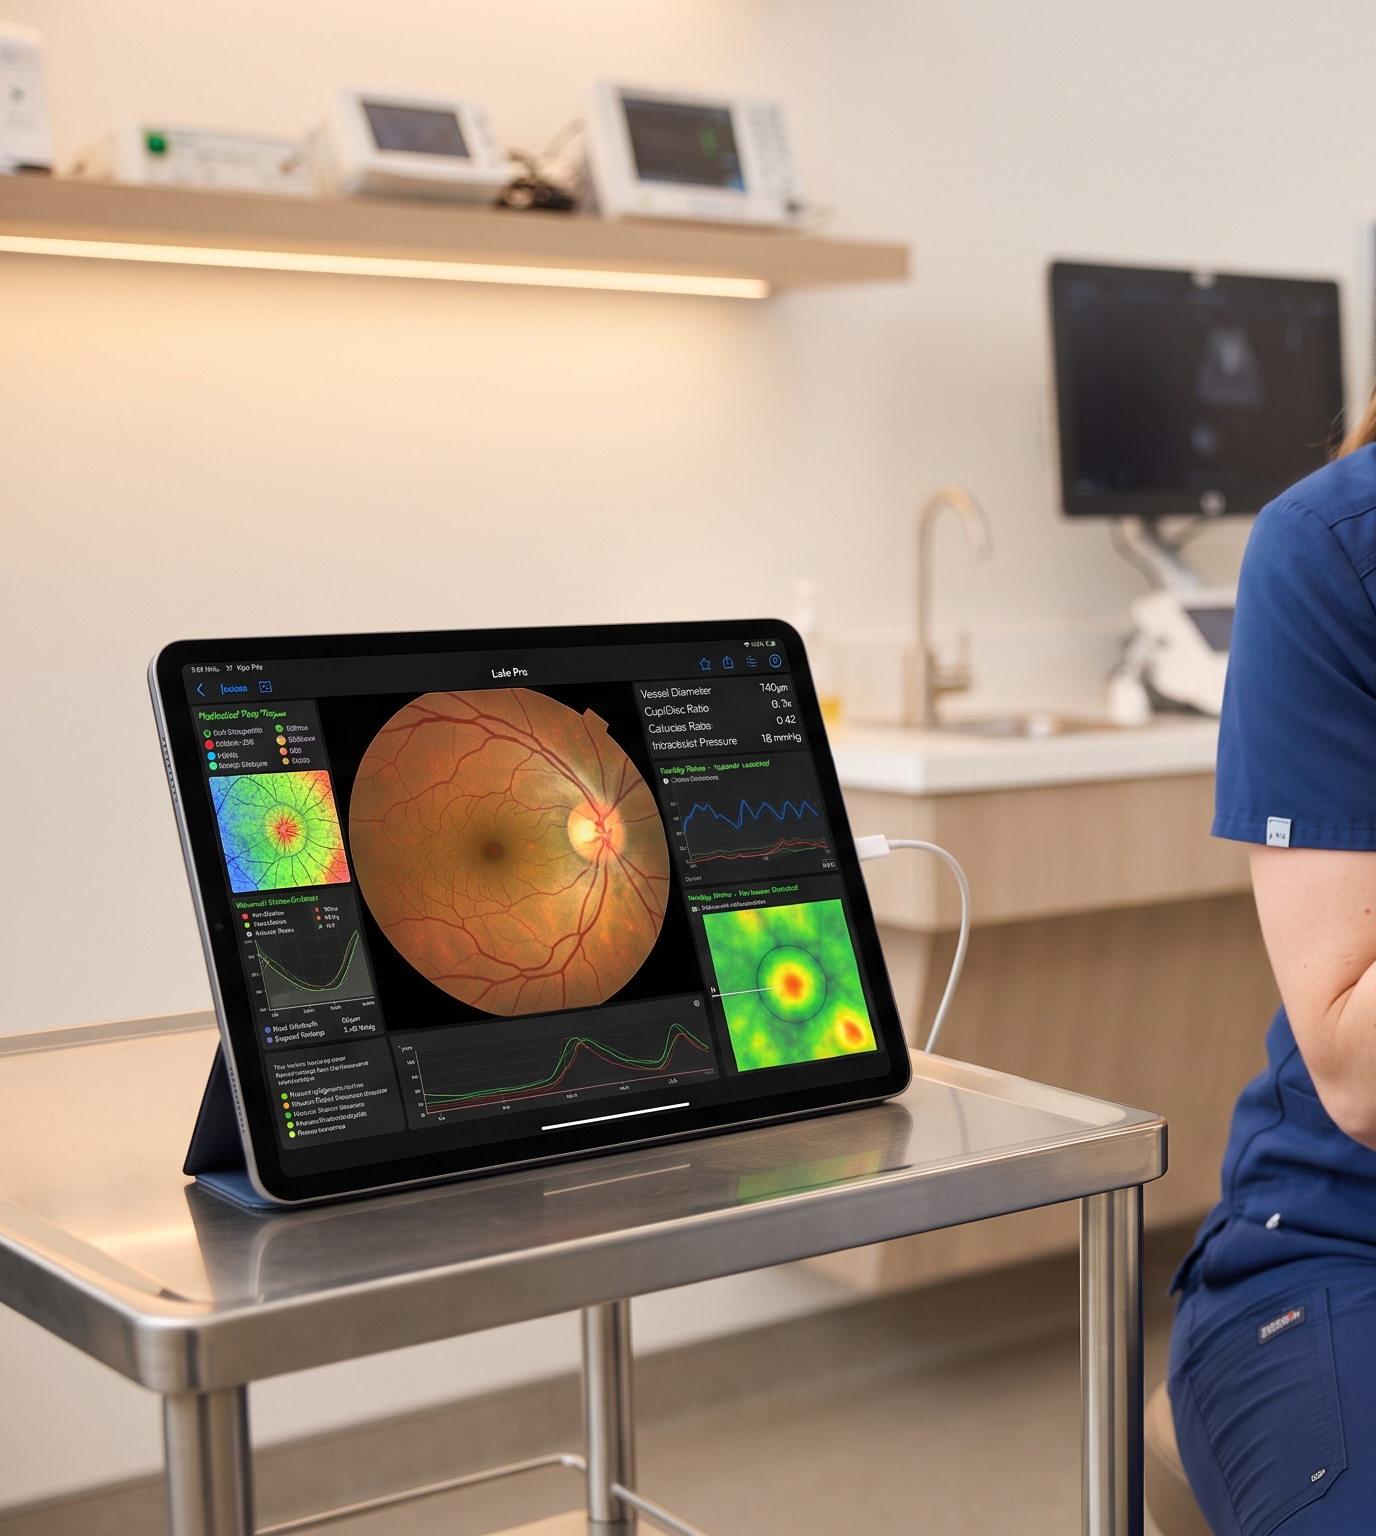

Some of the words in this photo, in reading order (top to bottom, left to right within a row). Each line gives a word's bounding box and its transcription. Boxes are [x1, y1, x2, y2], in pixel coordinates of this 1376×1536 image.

[640, 688, 670, 699] Vessel
[686, 703, 710, 714] Ratio
[699, 737, 739, 747] Pressure
